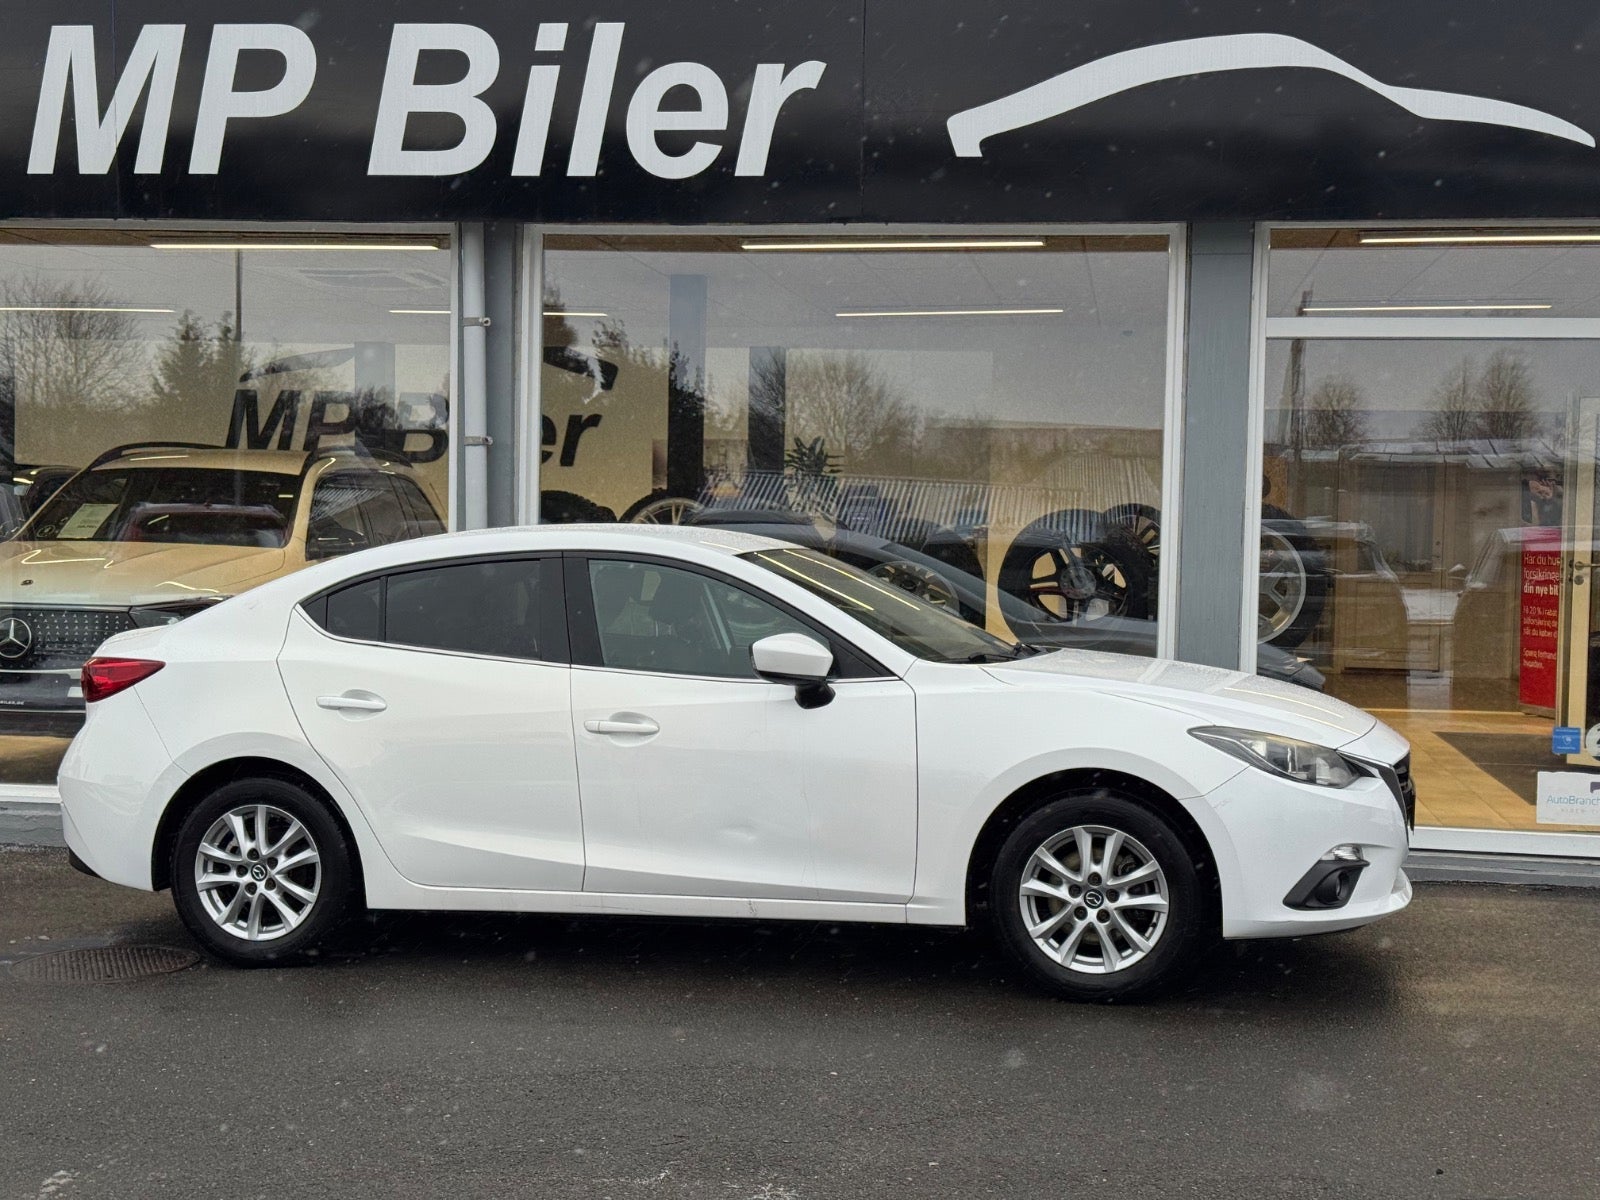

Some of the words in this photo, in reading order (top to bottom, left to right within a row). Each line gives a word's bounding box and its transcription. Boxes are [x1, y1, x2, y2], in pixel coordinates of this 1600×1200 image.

[27, 23, 317, 175] MP
[366, 22, 828, 179] Biler
[225, 388, 363, 451] MP
[1523, 553, 1535, 565] Har
[1536, 554, 1547, 565] du
[1523, 582, 1534, 594] din
[1535, 585, 1548, 597] nye
[1529, 606, 1537, 615] 20
